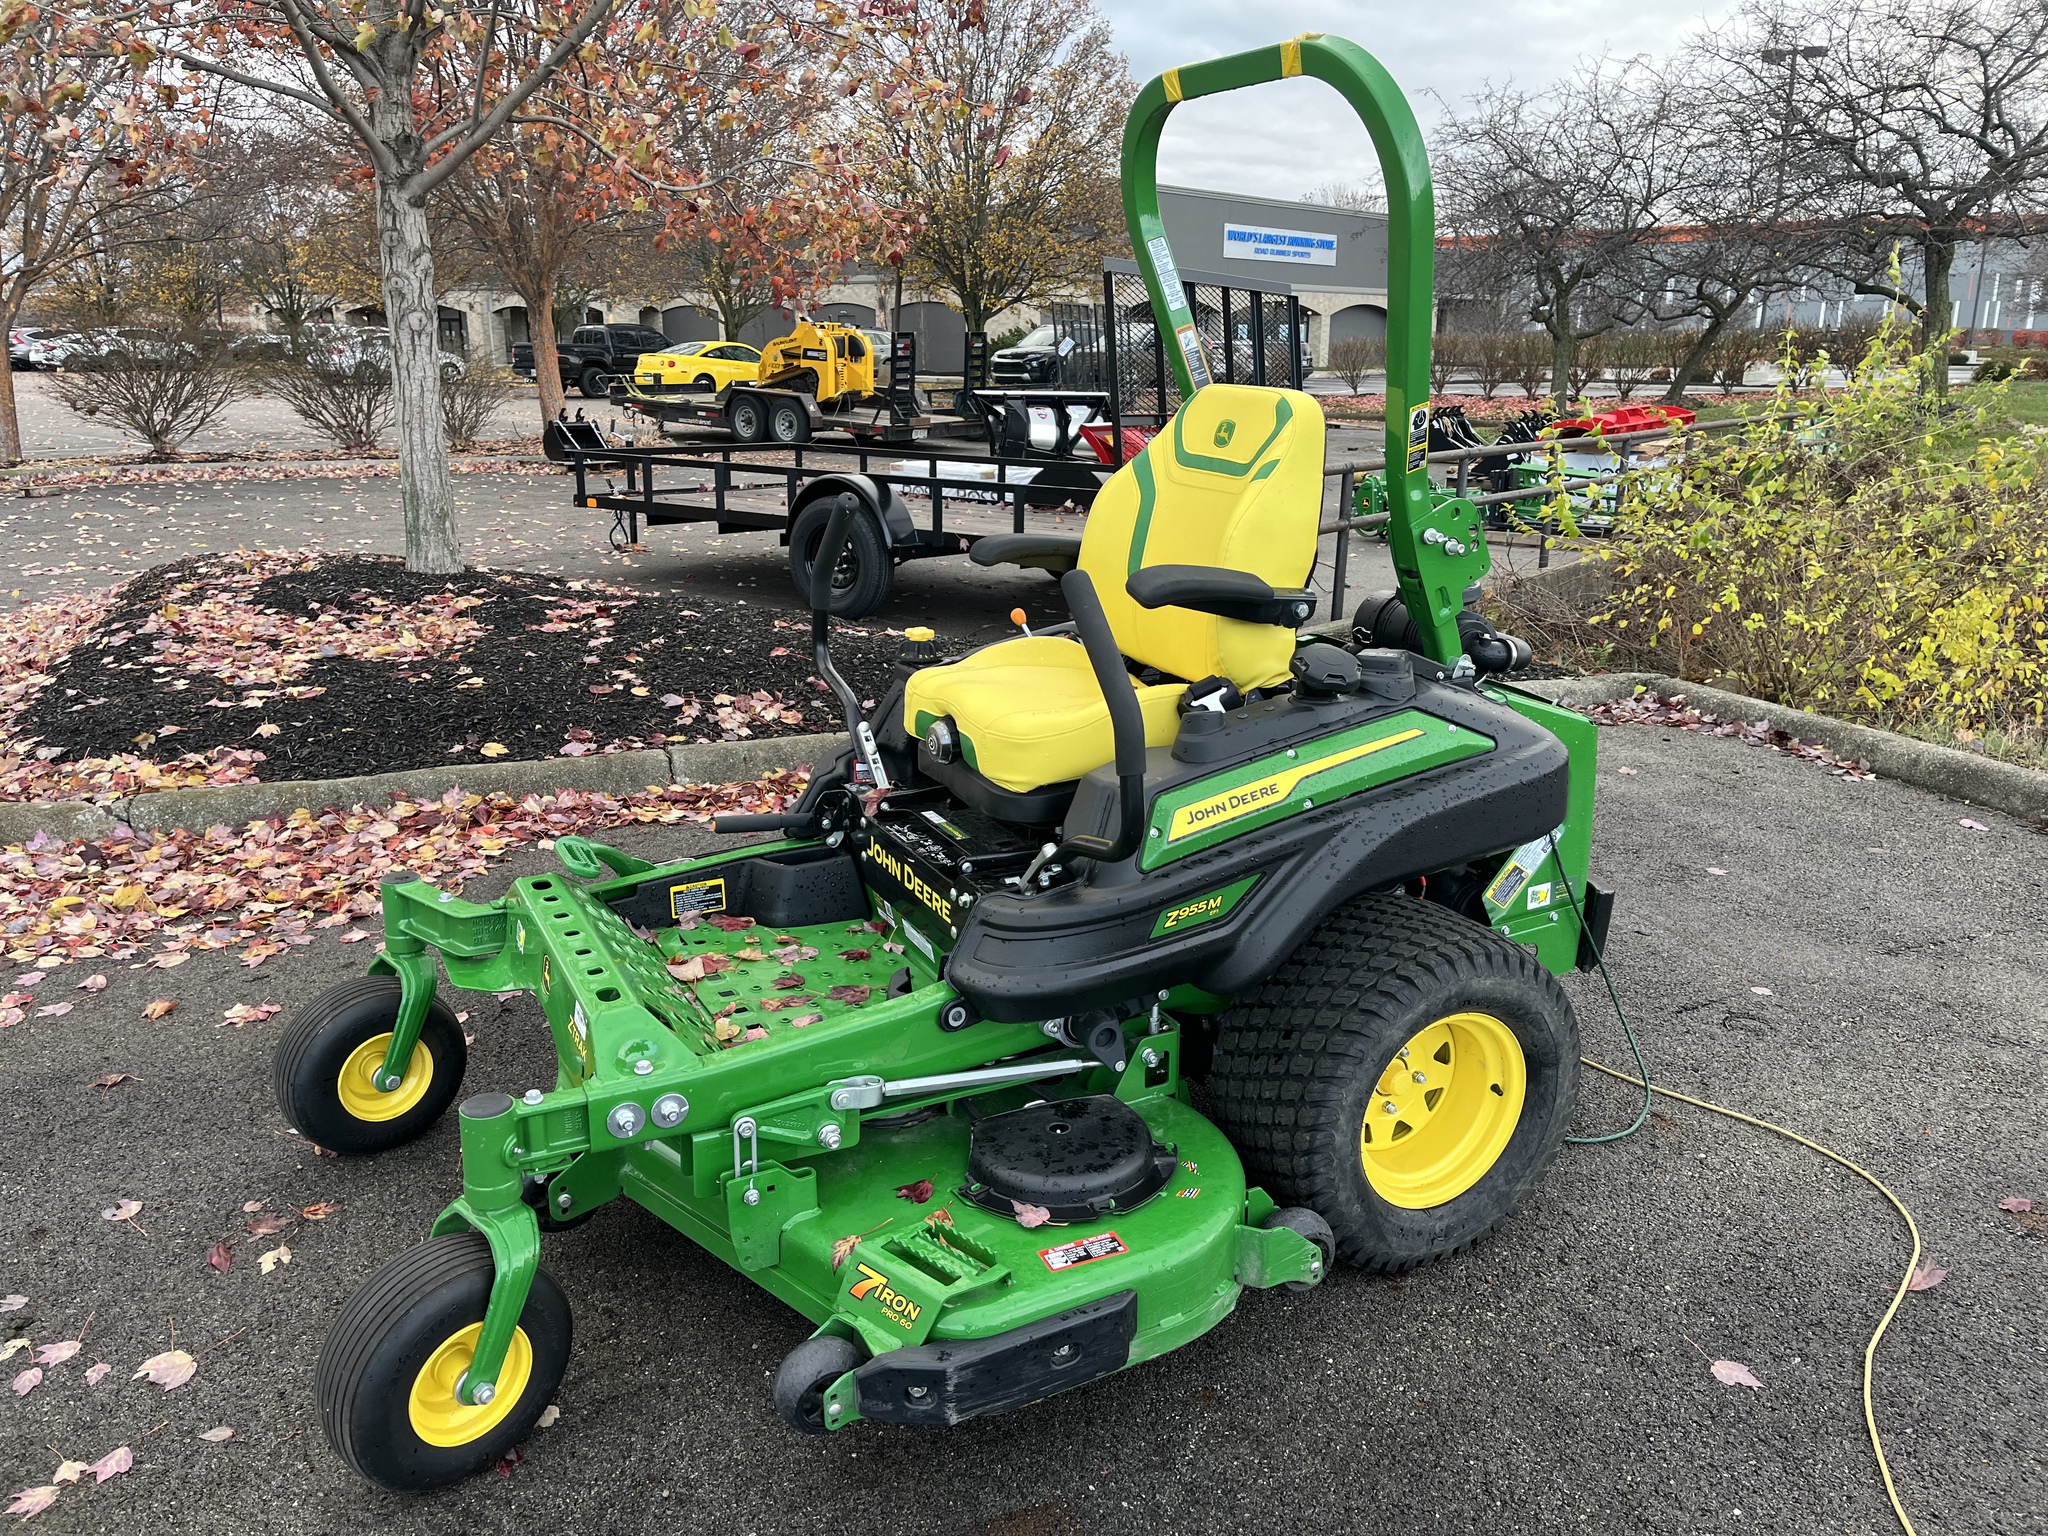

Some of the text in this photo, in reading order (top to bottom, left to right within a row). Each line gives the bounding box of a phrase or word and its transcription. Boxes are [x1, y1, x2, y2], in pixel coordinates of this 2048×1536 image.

[1227, 230, 1259, 243] WORLD'S
[1259, 233, 1286, 246] LARGEST
[1286, 236, 1316, 249] RUNNING
[1254, 247, 1311, 259] ROAD RUNNER SPORTS
[1187, 783, 1280, 825] JOHN DEERE
[866, 836, 902, 883] JOHN
[904, 863, 952, 924] DEERE
[1163, 895, 1224, 929] Z955M
[567, 1014, 588, 1063] ZTRAK
[1053, 1242, 1076, 1252] DANGER
[848, 1262, 922, 1322] 7 IRON
[881, 1306, 913, 1330] PRO 60
